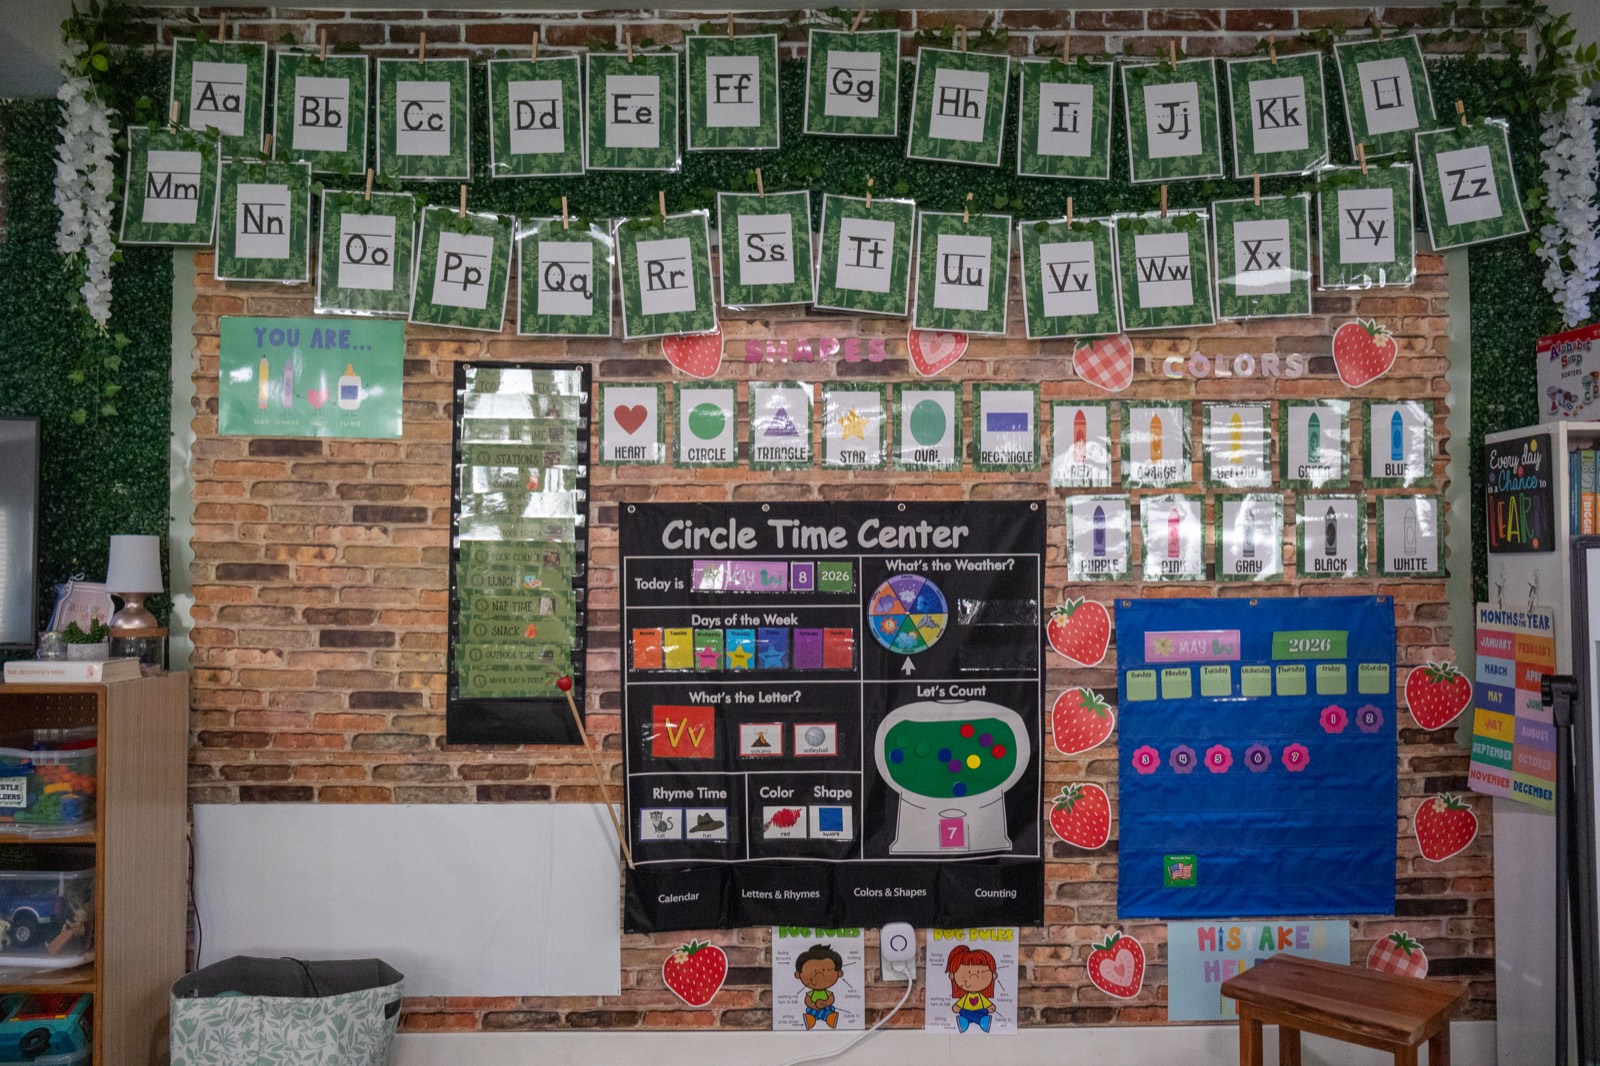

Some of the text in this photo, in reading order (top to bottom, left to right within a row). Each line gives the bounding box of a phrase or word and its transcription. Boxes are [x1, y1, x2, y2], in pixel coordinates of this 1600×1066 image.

[715, 74, 752, 103] Ff
[832, 68, 875, 103] Gg
[1375, 76, 1402, 110] Ll
[196, 82, 241, 112] Aa
[939, 88, 980, 118] Hh
[302, 97, 342, 128] Bb
[403, 101, 444, 131] Cc
[516, 100, 557, 130] Dd
[613, 94, 653, 125] Ee
[1258, 97, 1300, 128] Kk
[1051, 102, 1079, 133] Ii
[1157, 103, 1189, 140] Jj
[147, 173, 197, 199] Mm
[1445, 168, 1490, 201] Zz
[243, 204, 283, 235] Nn
[1346, 208, 1386, 246] Yy
[345, 234, 389, 266] Oo
[746, 233, 786, 263] Ss
[849, 236, 884, 268] Tt
[1242, 240, 1281, 271] Xx
[443, 253, 482, 291] Pp
[647, 261, 685, 290] Rr
[942, 254, 983, 286] Uu
[1139, 257, 1189, 282] Ww
[544, 262, 593, 300] Qq
[1049, 263, 1088, 293] Vv
[253, 326, 372, 350] YOU ARE...
[745, 338, 886, 363] SHAPES
[1550, 338, 1592, 361] Alphabet
[1163, 352, 1304, 378] COLORS
[1561, 354, 1582, 369] Soup
[1561, 369, 1582, 379] SORTERS
[495, 455, 538, 465] STATIONS
[614, 446, 646, 459] HEART
[688, 448, 726, 461] CIRCLE
[757, 446, 806, 460] TRIANGLE
[839, 450, 865, 463] STAR
[1489, 442, 1542, 472] Every day
[1497, 471, 1538, 492] Chance
[1539, 479, 1547, 488] to
[1489, 493, 1547, 547] LEARN
[662, 518, 969, 550] Circle Time Center
[885, 559, 1015, 571] What's the Weather?
[1081, 559, 1119, 572] PURPLE
[1235, 560, 1263, 573] GRAY
[1315, 558, 1347, 571] BLACK
[1394, 558, 1428, 571] WHITE
[487, 576, 517, 588] LUNCH
[798, 571, 808, 584] 8
[821, 571, 850, 582] 2026
[634, 577, 684, 592] Today is
[492, 601, 533, 613] NAP TIME
[691, 613, 798, 627] Days of the Week
[1480, 609, 1518, 627] MONTHS
[1528, 612, 1550, 630] YEAR
[491, 626, 520, 637] SNACK
[1179, 640, 1207, 653] MAY
[1288, 638, 1331, 653] 2026
[1480, 636, 1512, 651] JANUARY
[1485, 663, 1508, 677] MARCH
[1525, 669, 1543, 683] APRI
[689, 691, 801, 704] What's the Letter?
[917, 685, 987, 697] Let's Count
[1488, 690, 1503, 704] MAY
[1526, 698, 1545, 712] JUNE
[1330, 713, 1337, 724] 1
[1365, 713, 1374, 724] 2
[1485, 718, 1503, 732] JULY
[665, 717, 706, 748] Vv
[1521, 726, 1549, 742] AUGUST
[1141, 754, 1149, 764] 3
[1178, 754, 1187, 764] 4
[1214, 754, 1222, 764] 5
[1254, 753, 1262, 763] 6
[1291, 752, 1300, 762] 7
[1472, 742, 1513, 761] SEPTEMBER
[1469, 768, 1510, 789] NOVEMBER
[653, 787, 727, 801] Rhyme Time
[759, 786, 794, 798] Color
[813, 786, 853, 800] Shape
[1513, 780, 1553, 801] DECEMBER
[947, 827, 958, 840] 7
[658, 892, 700, 903] Calendar
[741, 889, 820, 901] Letters & Rhymes
[854, 887, 927, 898] Colors & Shapes
[975, 888, 1017, 899] Counting
[933, 928, 1014, 942] RUG RULES
[1197, 925, 1328, 952] MISTAKES
